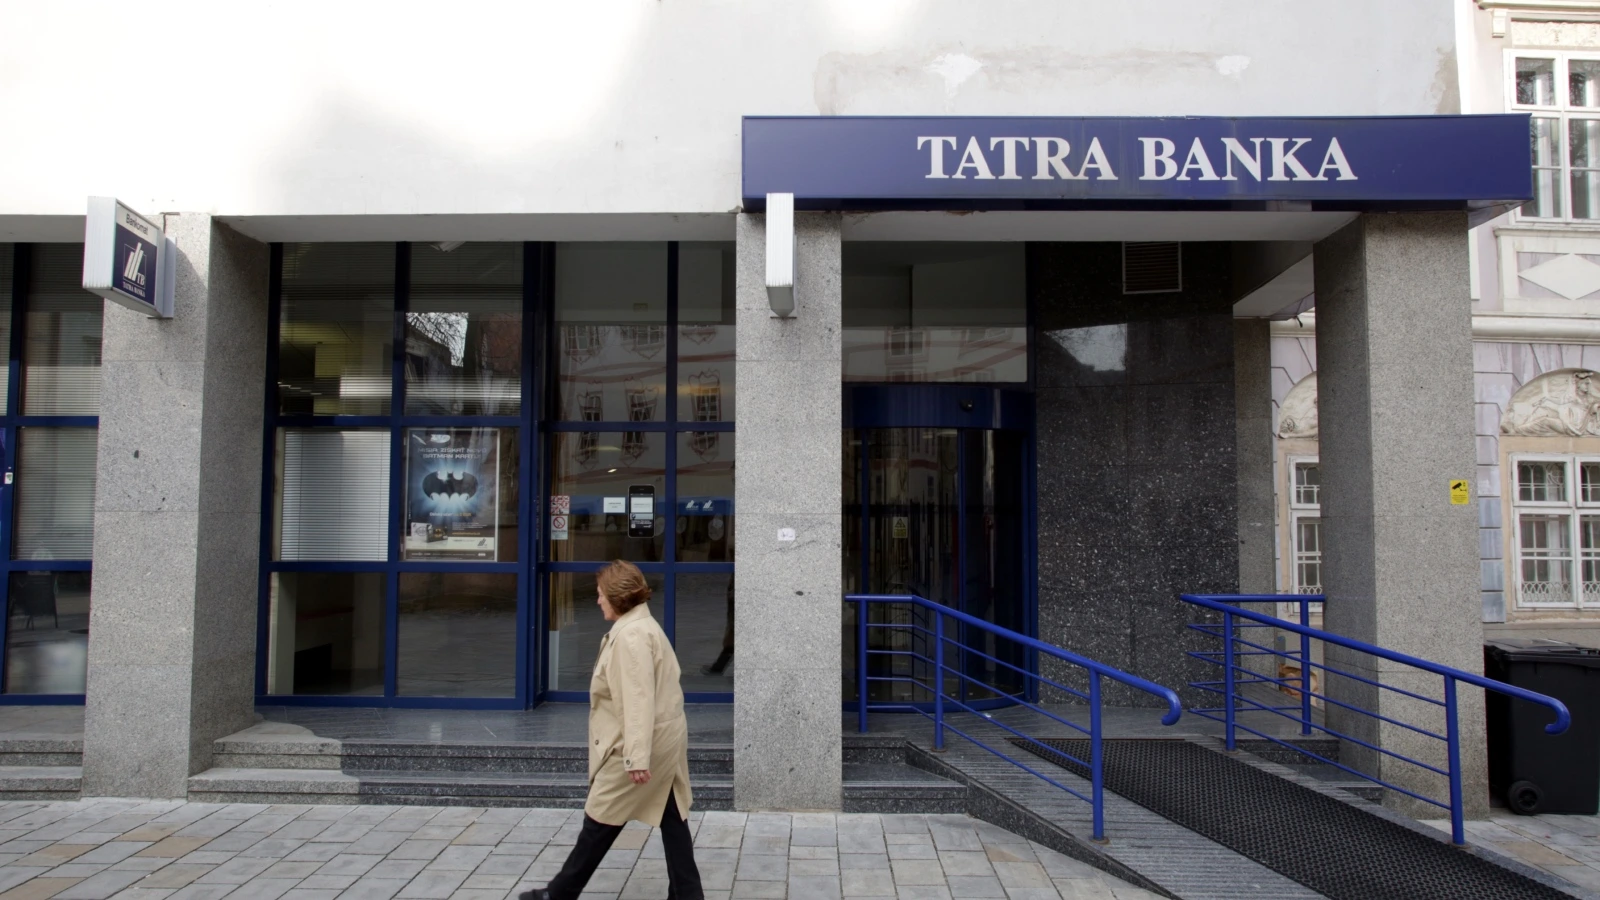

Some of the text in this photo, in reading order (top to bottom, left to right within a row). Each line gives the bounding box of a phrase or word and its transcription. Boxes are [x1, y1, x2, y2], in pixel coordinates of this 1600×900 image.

[917, 136, 1358, 181] TATRA BANKA
[126, 213, 148, 235] Bankomat
[137, 272, 146, 286] TB
